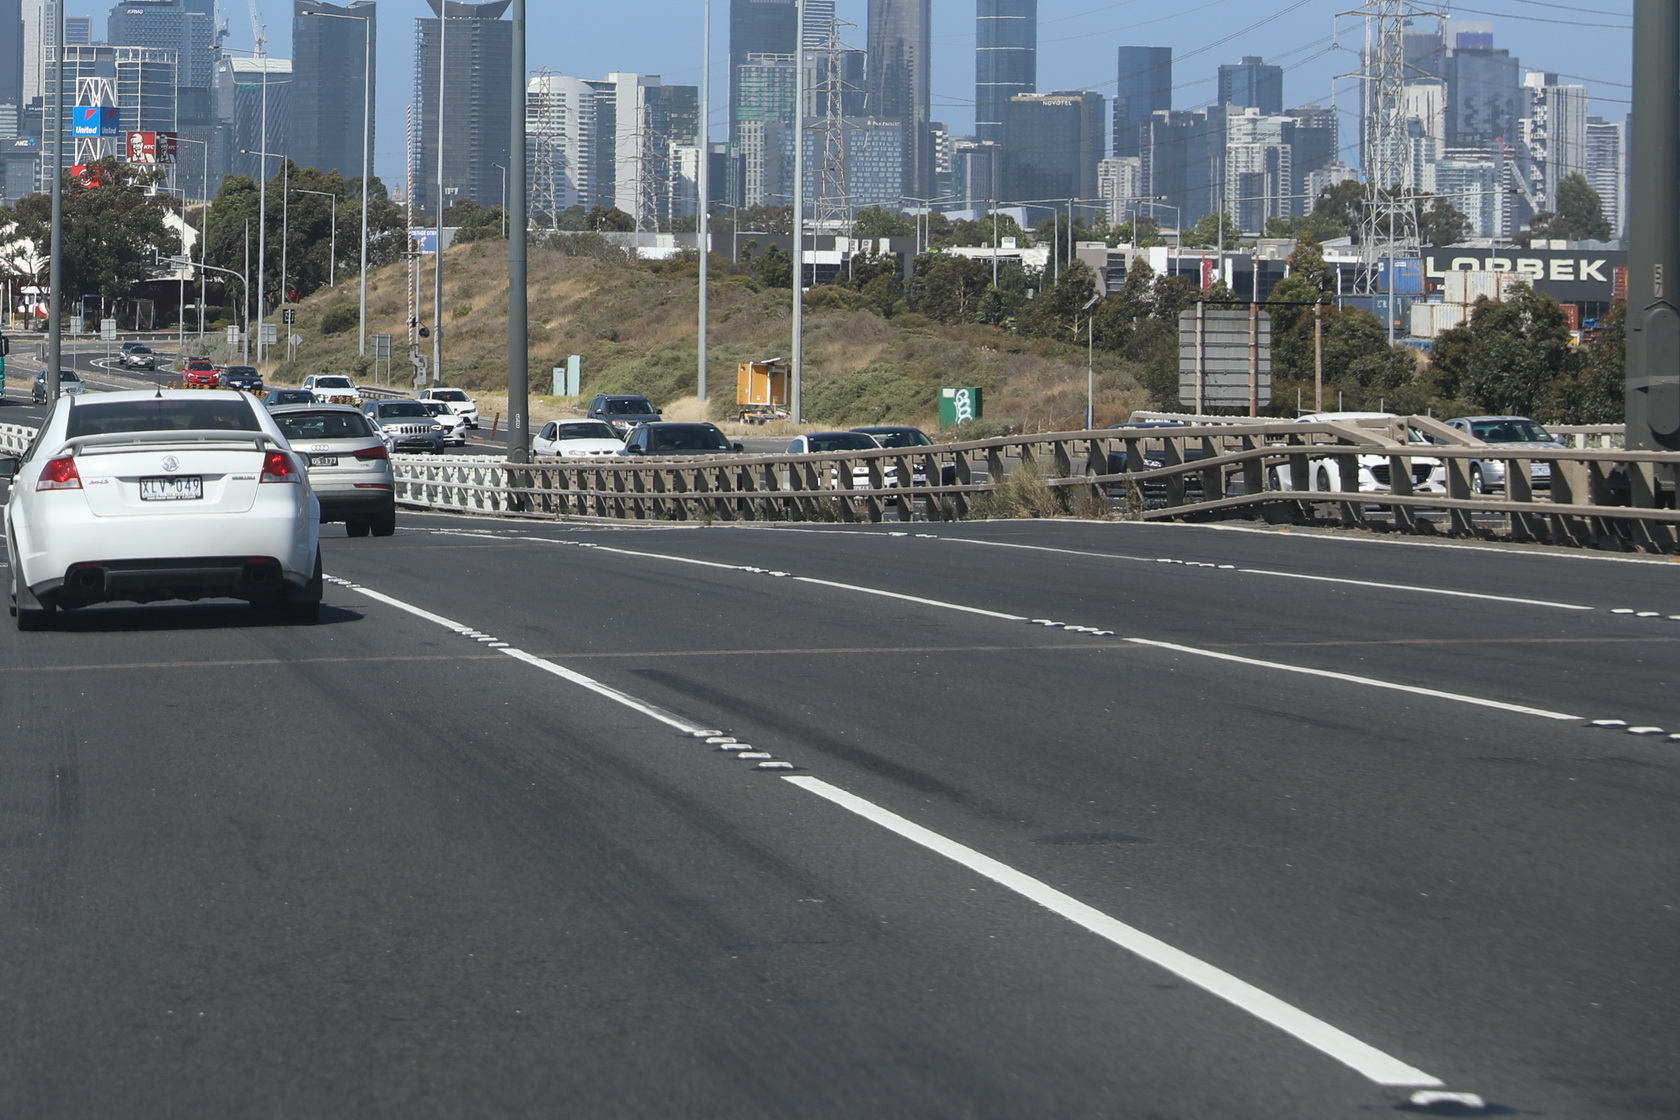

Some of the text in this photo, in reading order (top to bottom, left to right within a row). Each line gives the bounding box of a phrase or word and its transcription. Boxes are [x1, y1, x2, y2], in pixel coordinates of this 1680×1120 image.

[75, 126, 97, 134] United
[324, 457, 337, 465] 177
[142, 478, 199, 494] XLV 049
